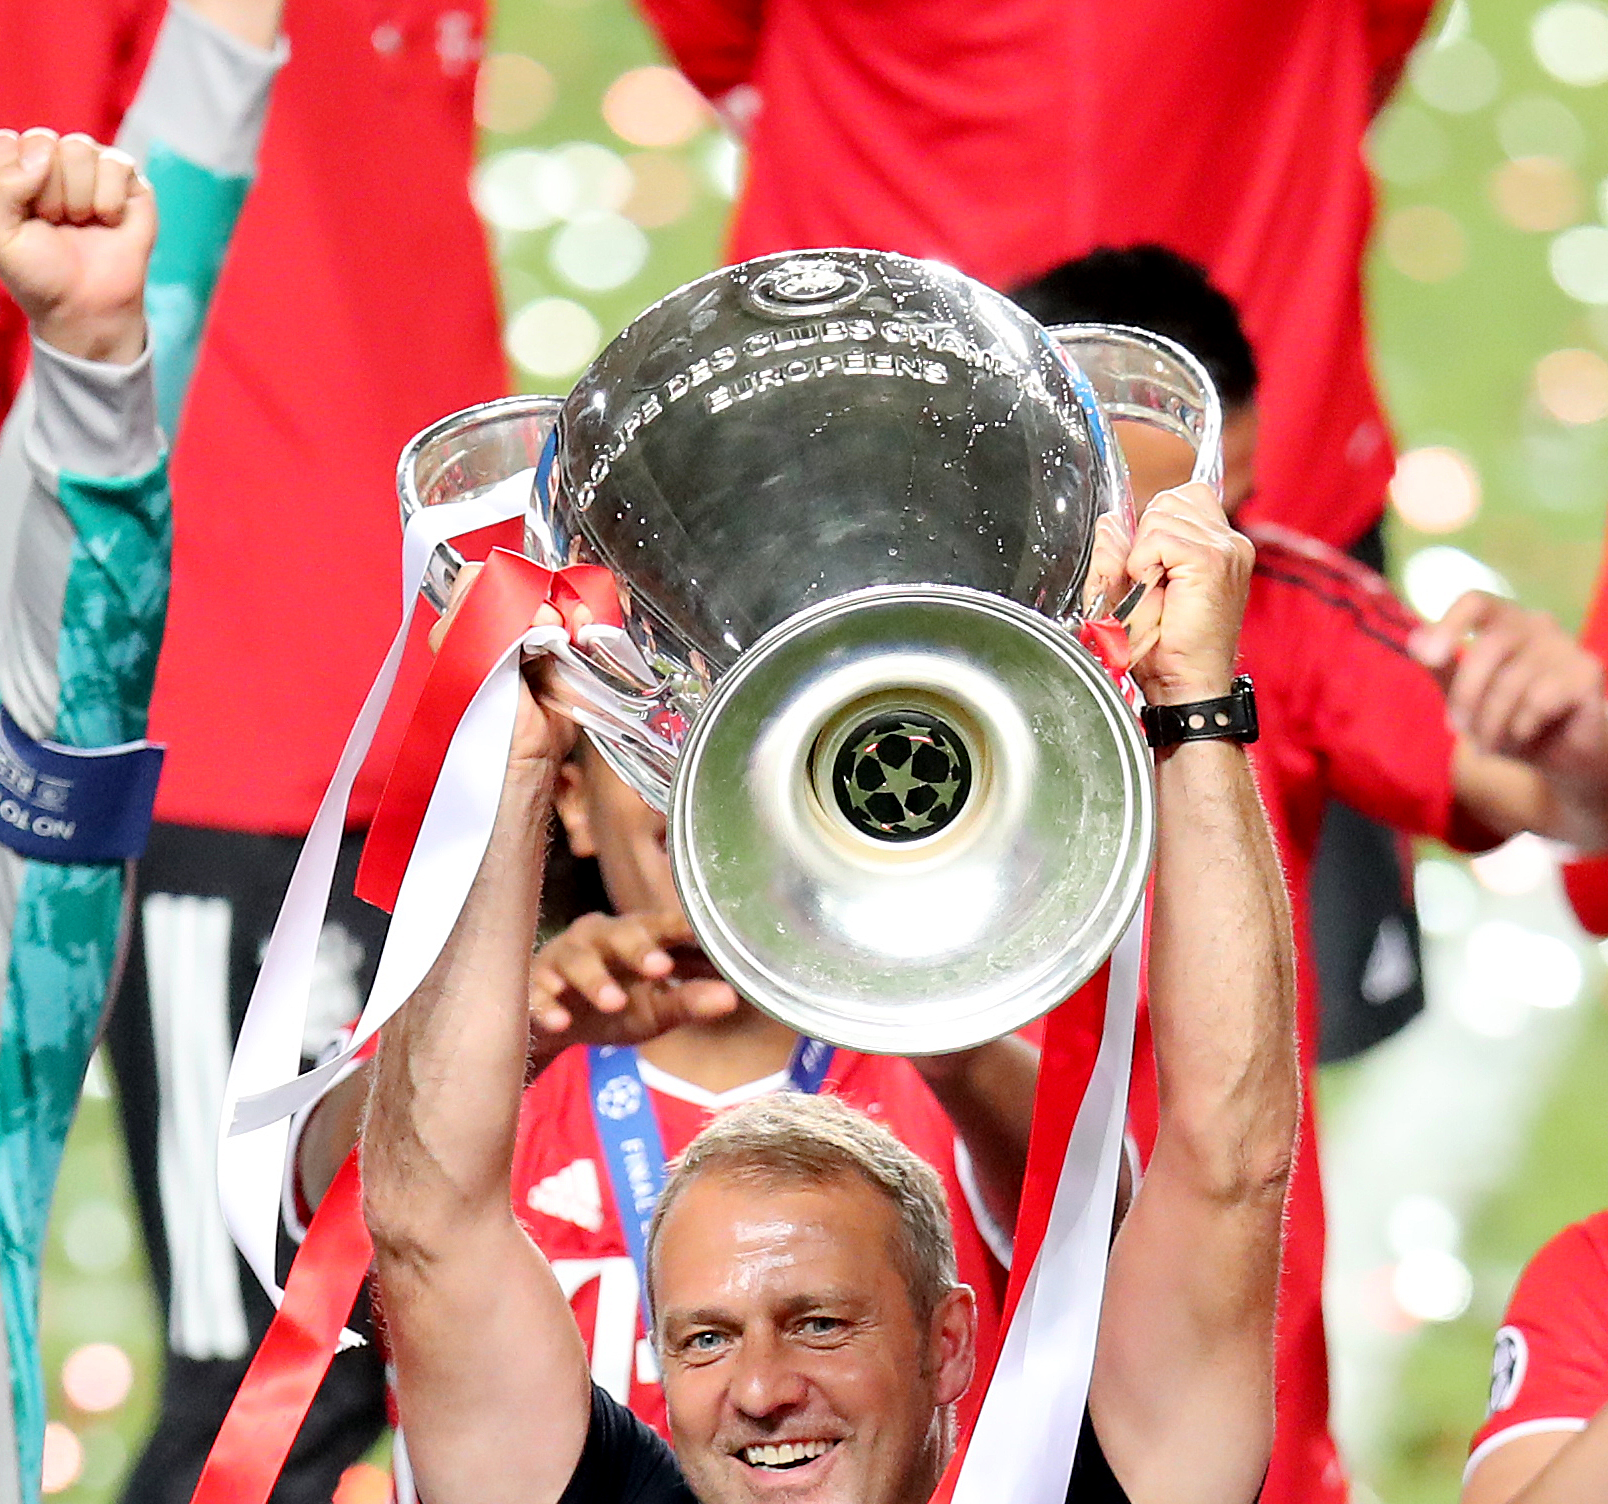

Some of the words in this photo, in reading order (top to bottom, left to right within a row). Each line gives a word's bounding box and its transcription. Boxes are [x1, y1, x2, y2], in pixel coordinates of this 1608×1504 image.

[577, 394, 663, 512] COUPE
[665, 346, 737, 402] DES
[743, 319, 876, 357] CLUBS
[31, 815, 77, 840] NO
